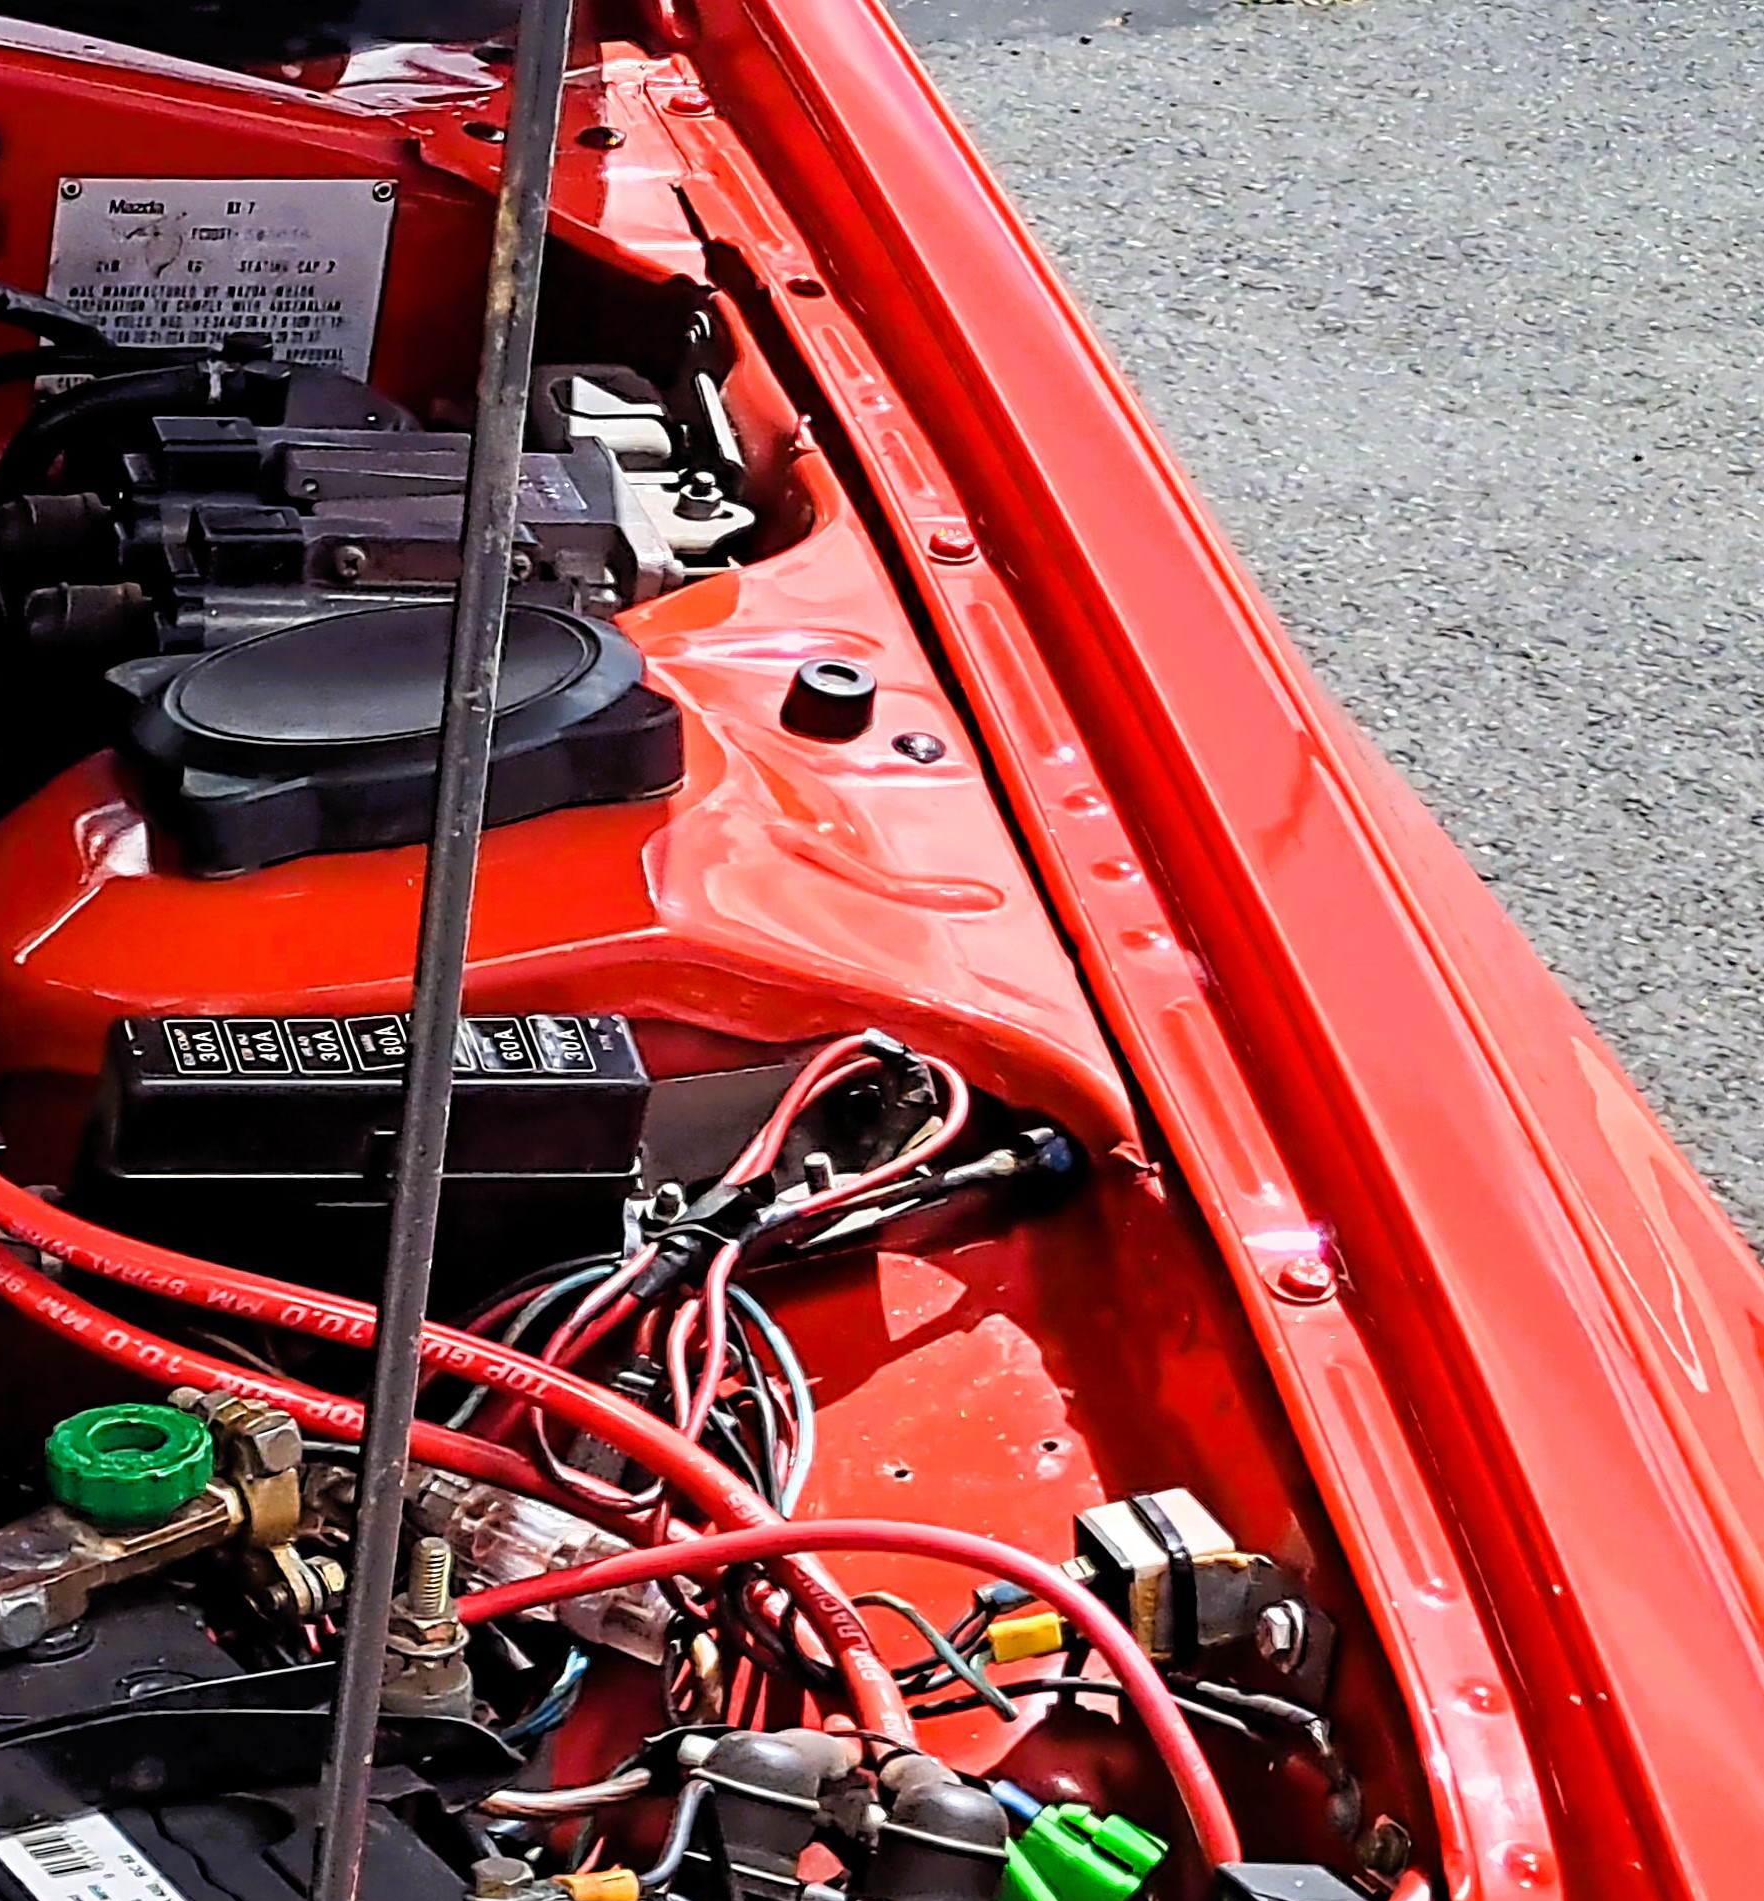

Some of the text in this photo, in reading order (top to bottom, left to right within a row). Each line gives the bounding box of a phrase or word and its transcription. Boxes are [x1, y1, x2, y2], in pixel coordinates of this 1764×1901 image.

[109, 199, 165, 215] Mazda
[192, 1030, 220, 1062] 30A
[251, 1030, 280, 1062] 40A
[312, 1030, 340, 1062] 30A
[374, 1025, 405, 1055] 80A
[494, 1028, 524, 1061] 60A
[556, 1029, 584, 1061] 30A
[89, 1255, 188, 1295] SPIRAL
[36, 1292, 93, 1334] MM
[207, 1285, 266, 1316] MM
[282, 1302, 368, 1341] 10.0
[104, 1328, 184, 1376] 10.0
[420, 1335, 475, 1370] GU
[484, 1358, 550, 1400] TOP
